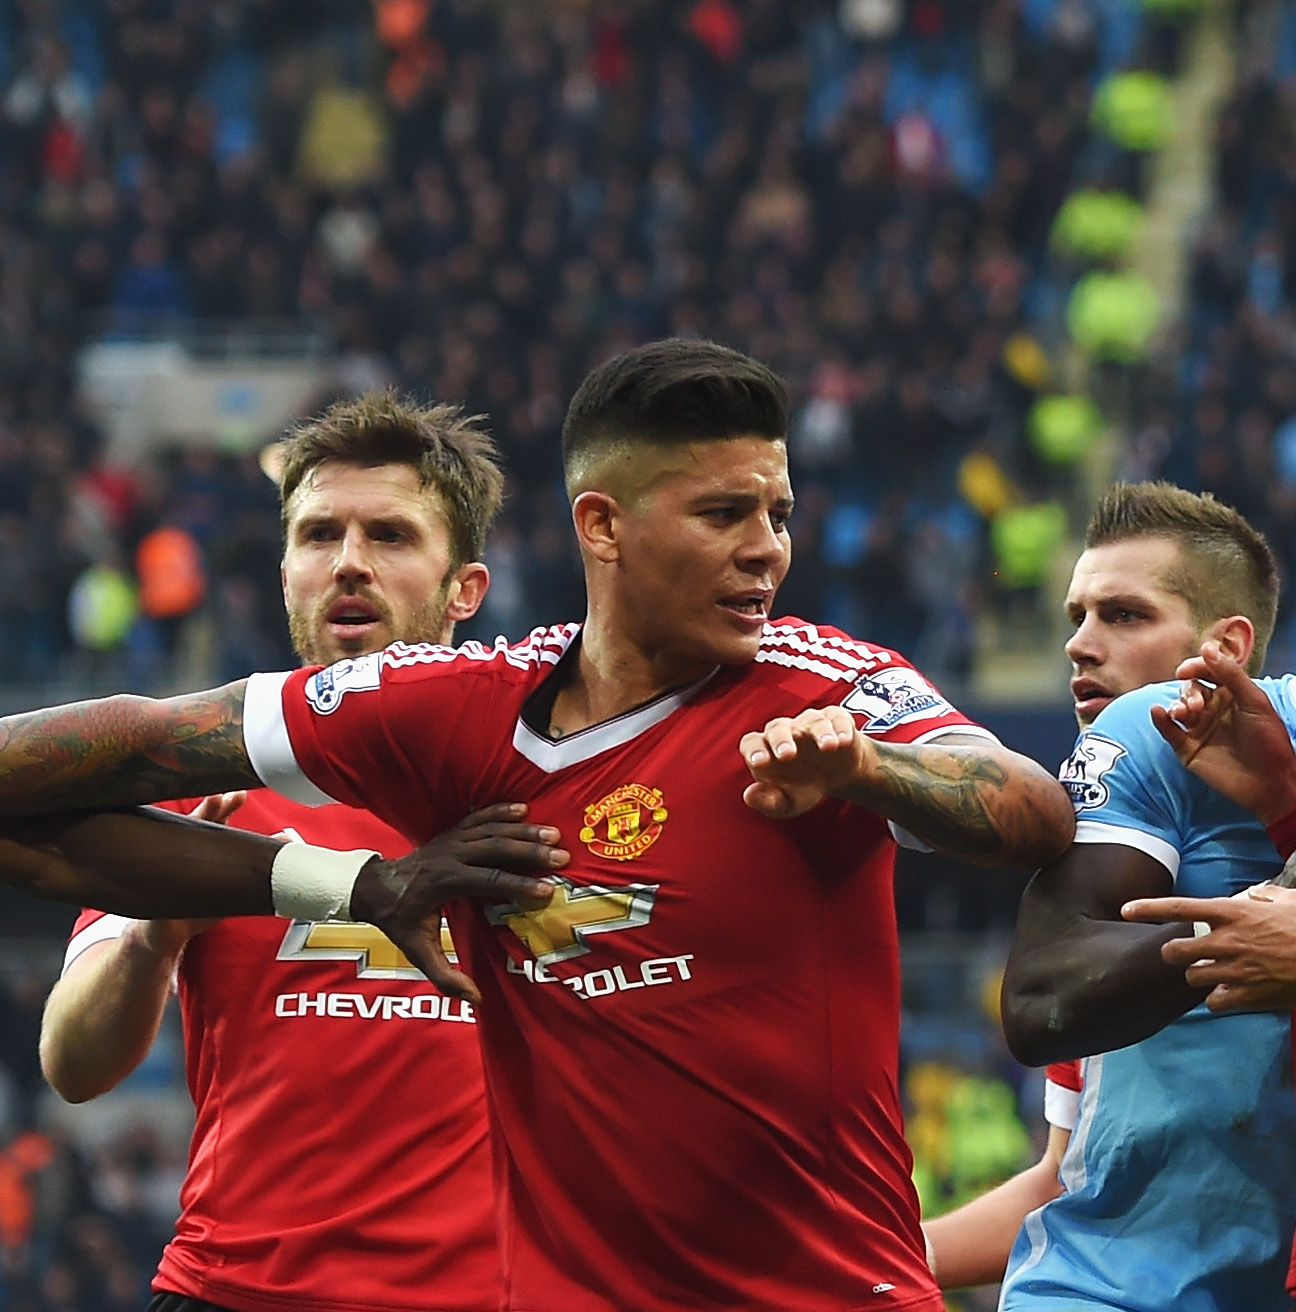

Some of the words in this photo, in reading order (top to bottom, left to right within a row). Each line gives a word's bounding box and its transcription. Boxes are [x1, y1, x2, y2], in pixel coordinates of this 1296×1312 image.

[590, 787, 658, 821] MANCHESTER
[604, 834, 652, 856] UNITED
[275, 992, 476, 1024] CHEVROLE
